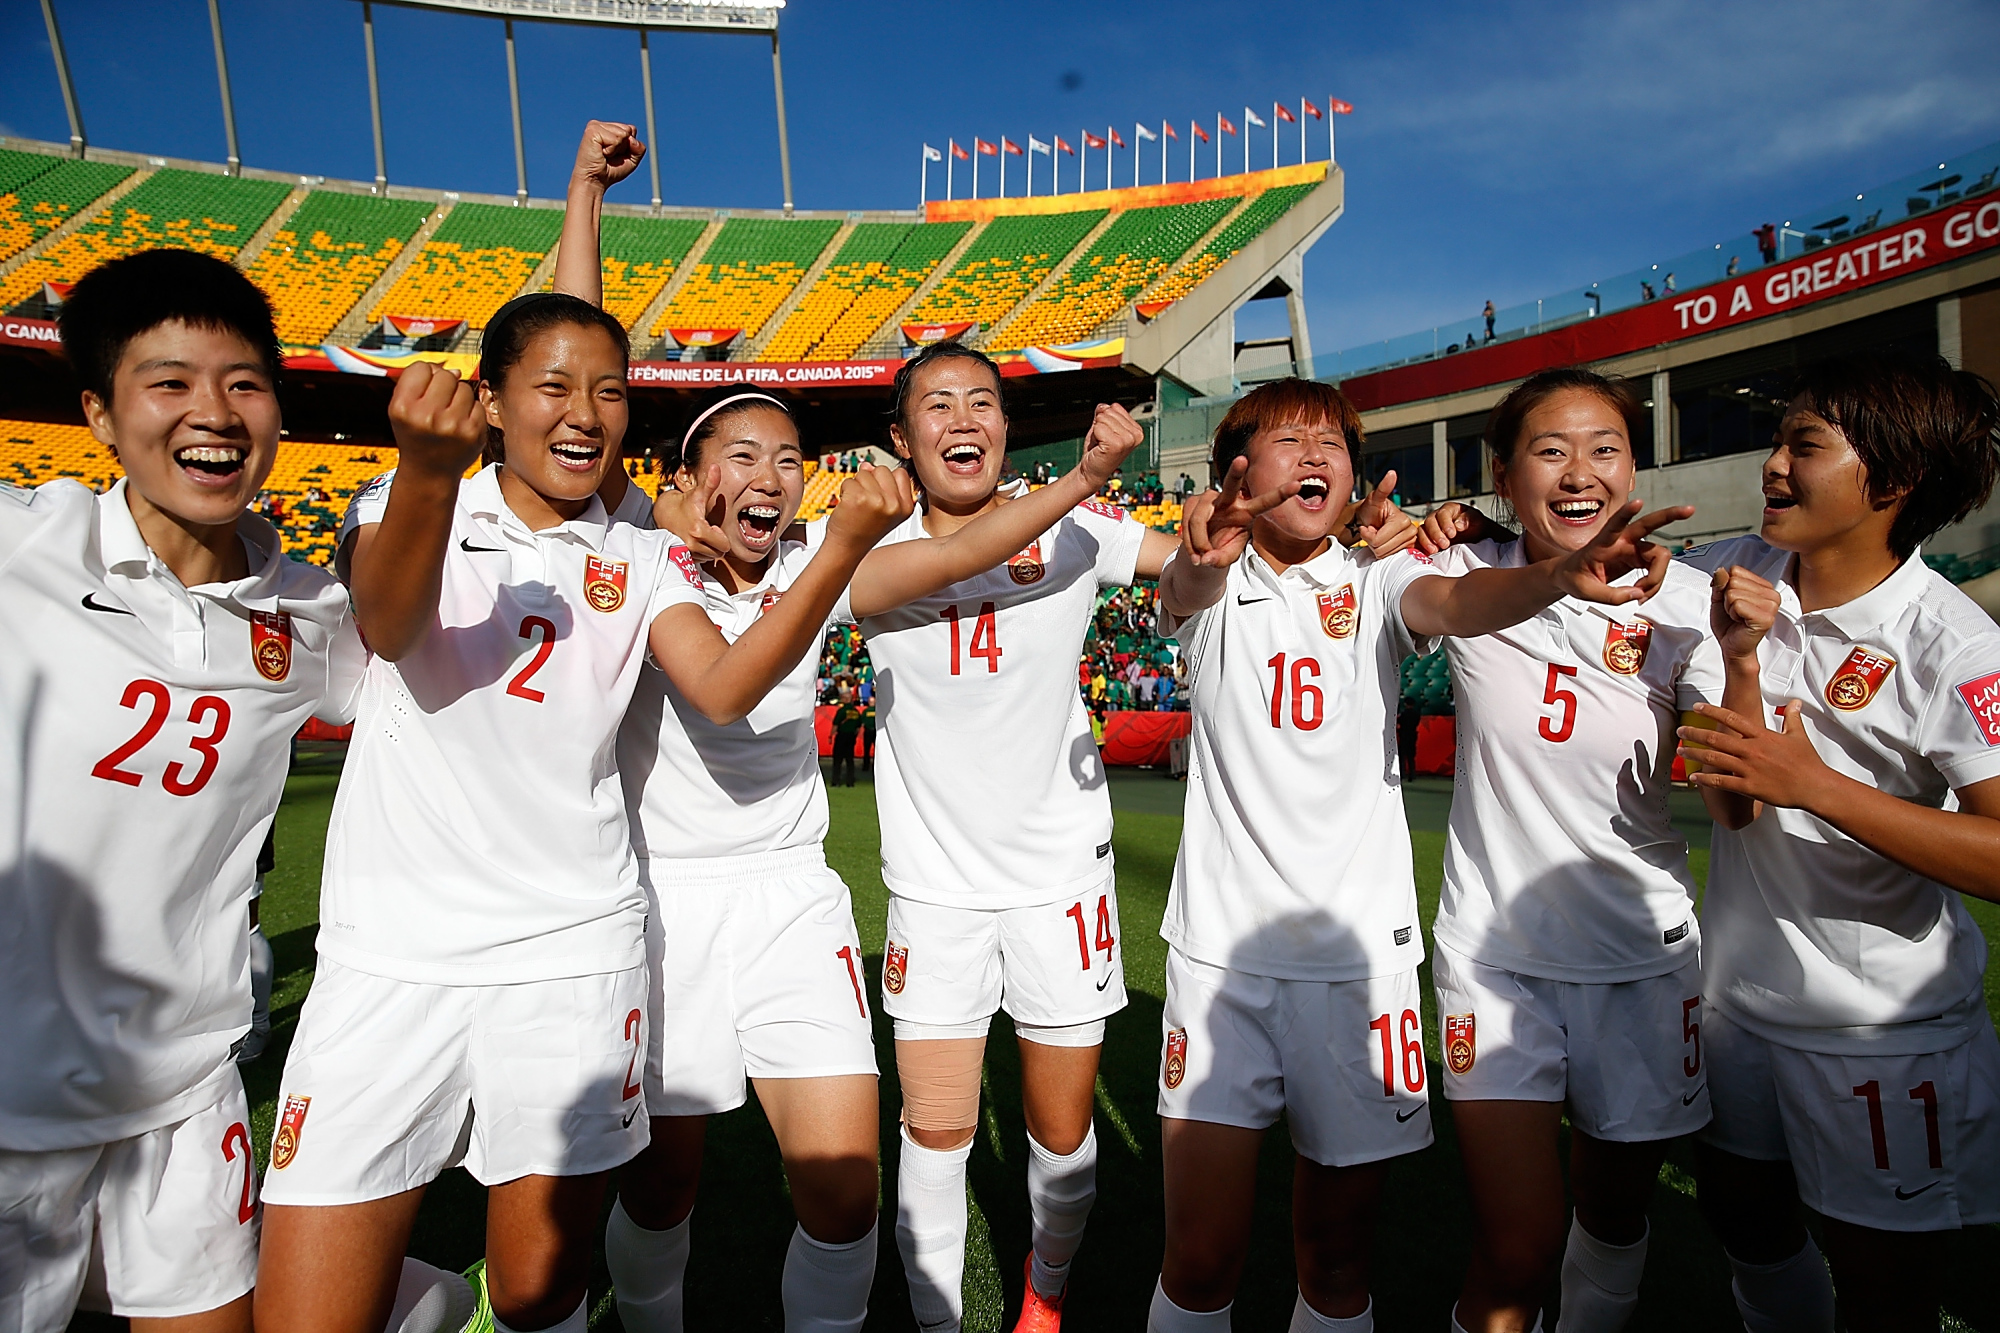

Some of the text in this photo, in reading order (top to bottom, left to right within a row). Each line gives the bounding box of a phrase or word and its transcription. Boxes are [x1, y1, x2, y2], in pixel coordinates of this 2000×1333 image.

[1673, 295, 1717, 329] TO
[1729, 284, 1753, 316] A
[1765, 228, 1927, 304] GREATER
[633, 364, 702, 382] FÉMININE
[702, 368, 723, 382] DE
[724, 368, 744, 382] LA
[745, 368, 784, 383] FIFA,
[785, 367, 843, 382] CANADA
[588, 558, 625, 576] CFA
[598, 571, 614, 581] 中国
[253, 611, 288, 629] CFA
[1319, 586, 1351, 606] CFA
[507, 616, 556, 704] 2
[940, 602, 1003, 676] 14
[1850, 651, 1890, 674] CFA
[1268, 652, 1324, 731] 16
[1855, 665, 1871, 677] 中国
[1973, 677, 2000, 707] LIV
[1539, 662, 1578, 743] 5
[91, 679, 231, 797] 23
[889, 944, 906, 960] CFA
[1066, 895, 1115, 971] 14
[1169, 1032, 1187, 1046] CFA
[1448, 1017, 1473, 1030] CFA
[1682, 995, 1700, 1078] 5
[624, 1008, 641, 1101] 2
[1369, 1008, 1425, 1097] 16
[1852, 1079, 1944, 1171] 11
